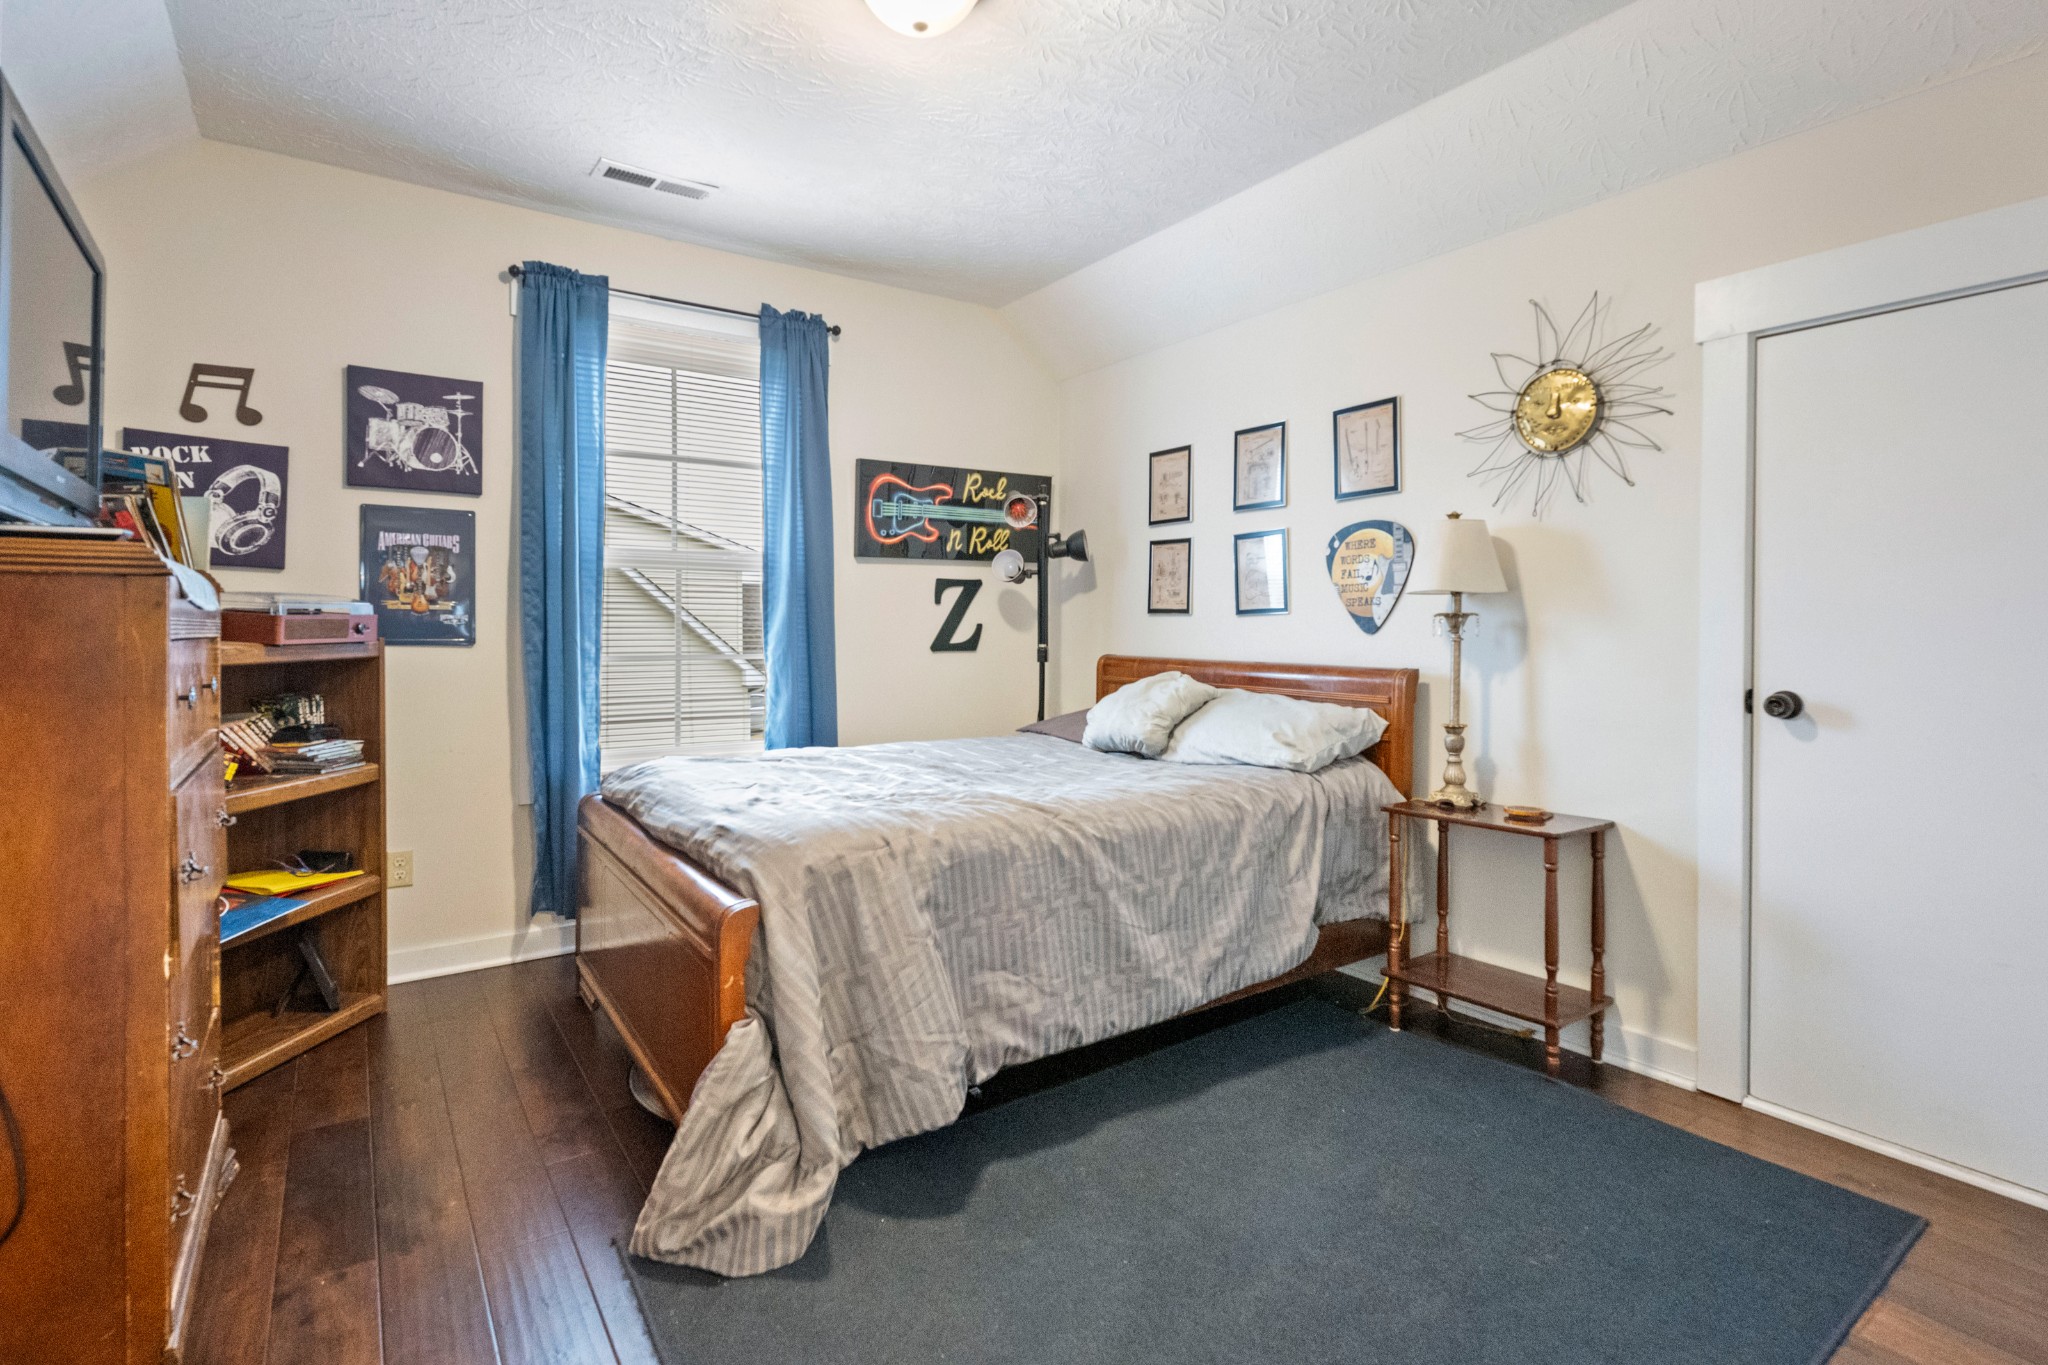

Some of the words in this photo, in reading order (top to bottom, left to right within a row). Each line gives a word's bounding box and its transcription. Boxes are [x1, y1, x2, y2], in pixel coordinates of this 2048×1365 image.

[962, 472, 1008, 504] Rock
[968, 526, 1011, 555] Roll
[1345, 538, 1377, 551] WHERE
[1340, 554, 1370, 565] WORDS
[1340, 569, 1365, 580] FAIL,
[1340, 583, 1369, 594] MUSIC
[1345, 597, 1382, 607] SPEAKS
[930, 578, 983, 653] Z
